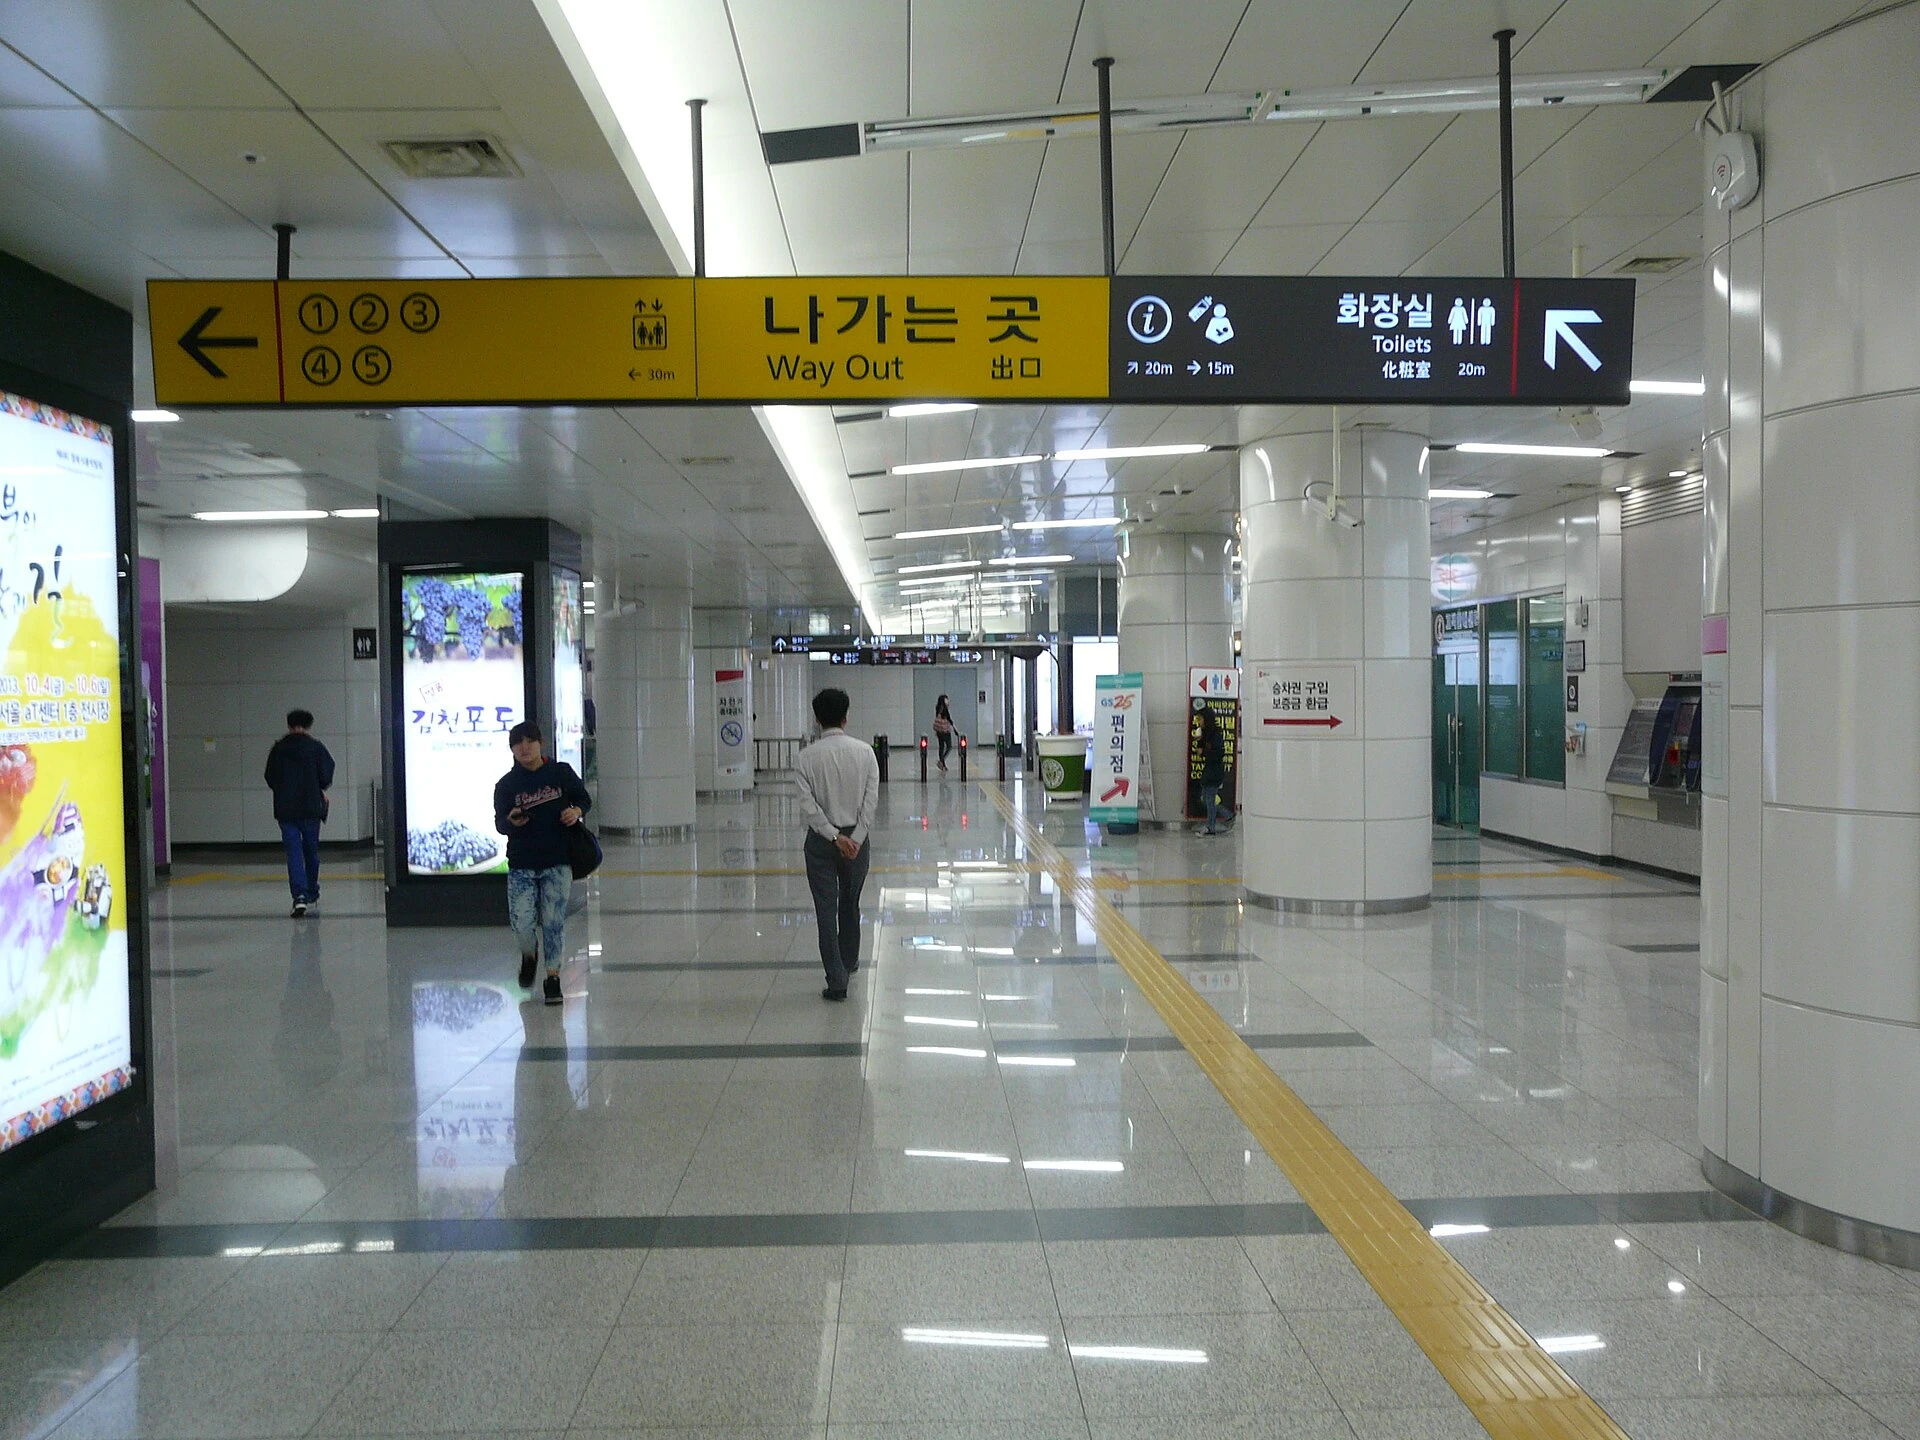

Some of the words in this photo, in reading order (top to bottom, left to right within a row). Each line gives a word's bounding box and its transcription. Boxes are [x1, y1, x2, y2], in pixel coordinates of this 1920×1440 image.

[765, 295, 958, 344] 나가는
[986, 295, 1041, 344] 곳
[1336, 292, 1433, 329] 화장실
[1372, 334, 1432, 354] Toilets
[647, 368, 676, 381] 30m
[766, 354, 836, 388] Way
[845, 354, 904, 381] Out
[990, 355, 1042, 380] 出口
[1144, 361, 1174, 376] 20m
[1207, 361, 1235, 376] 15m
[1382, 360, 1432, 379] 化粧室
[1458, 363, 1486, 377] 20m
[1272, 681, 1301, 695] 승차권
[1305, 681, 1329, 695] 구입
[1272, 697, 1302, 711] 보증금
[1109, 714, 1125, 774] 편의점
